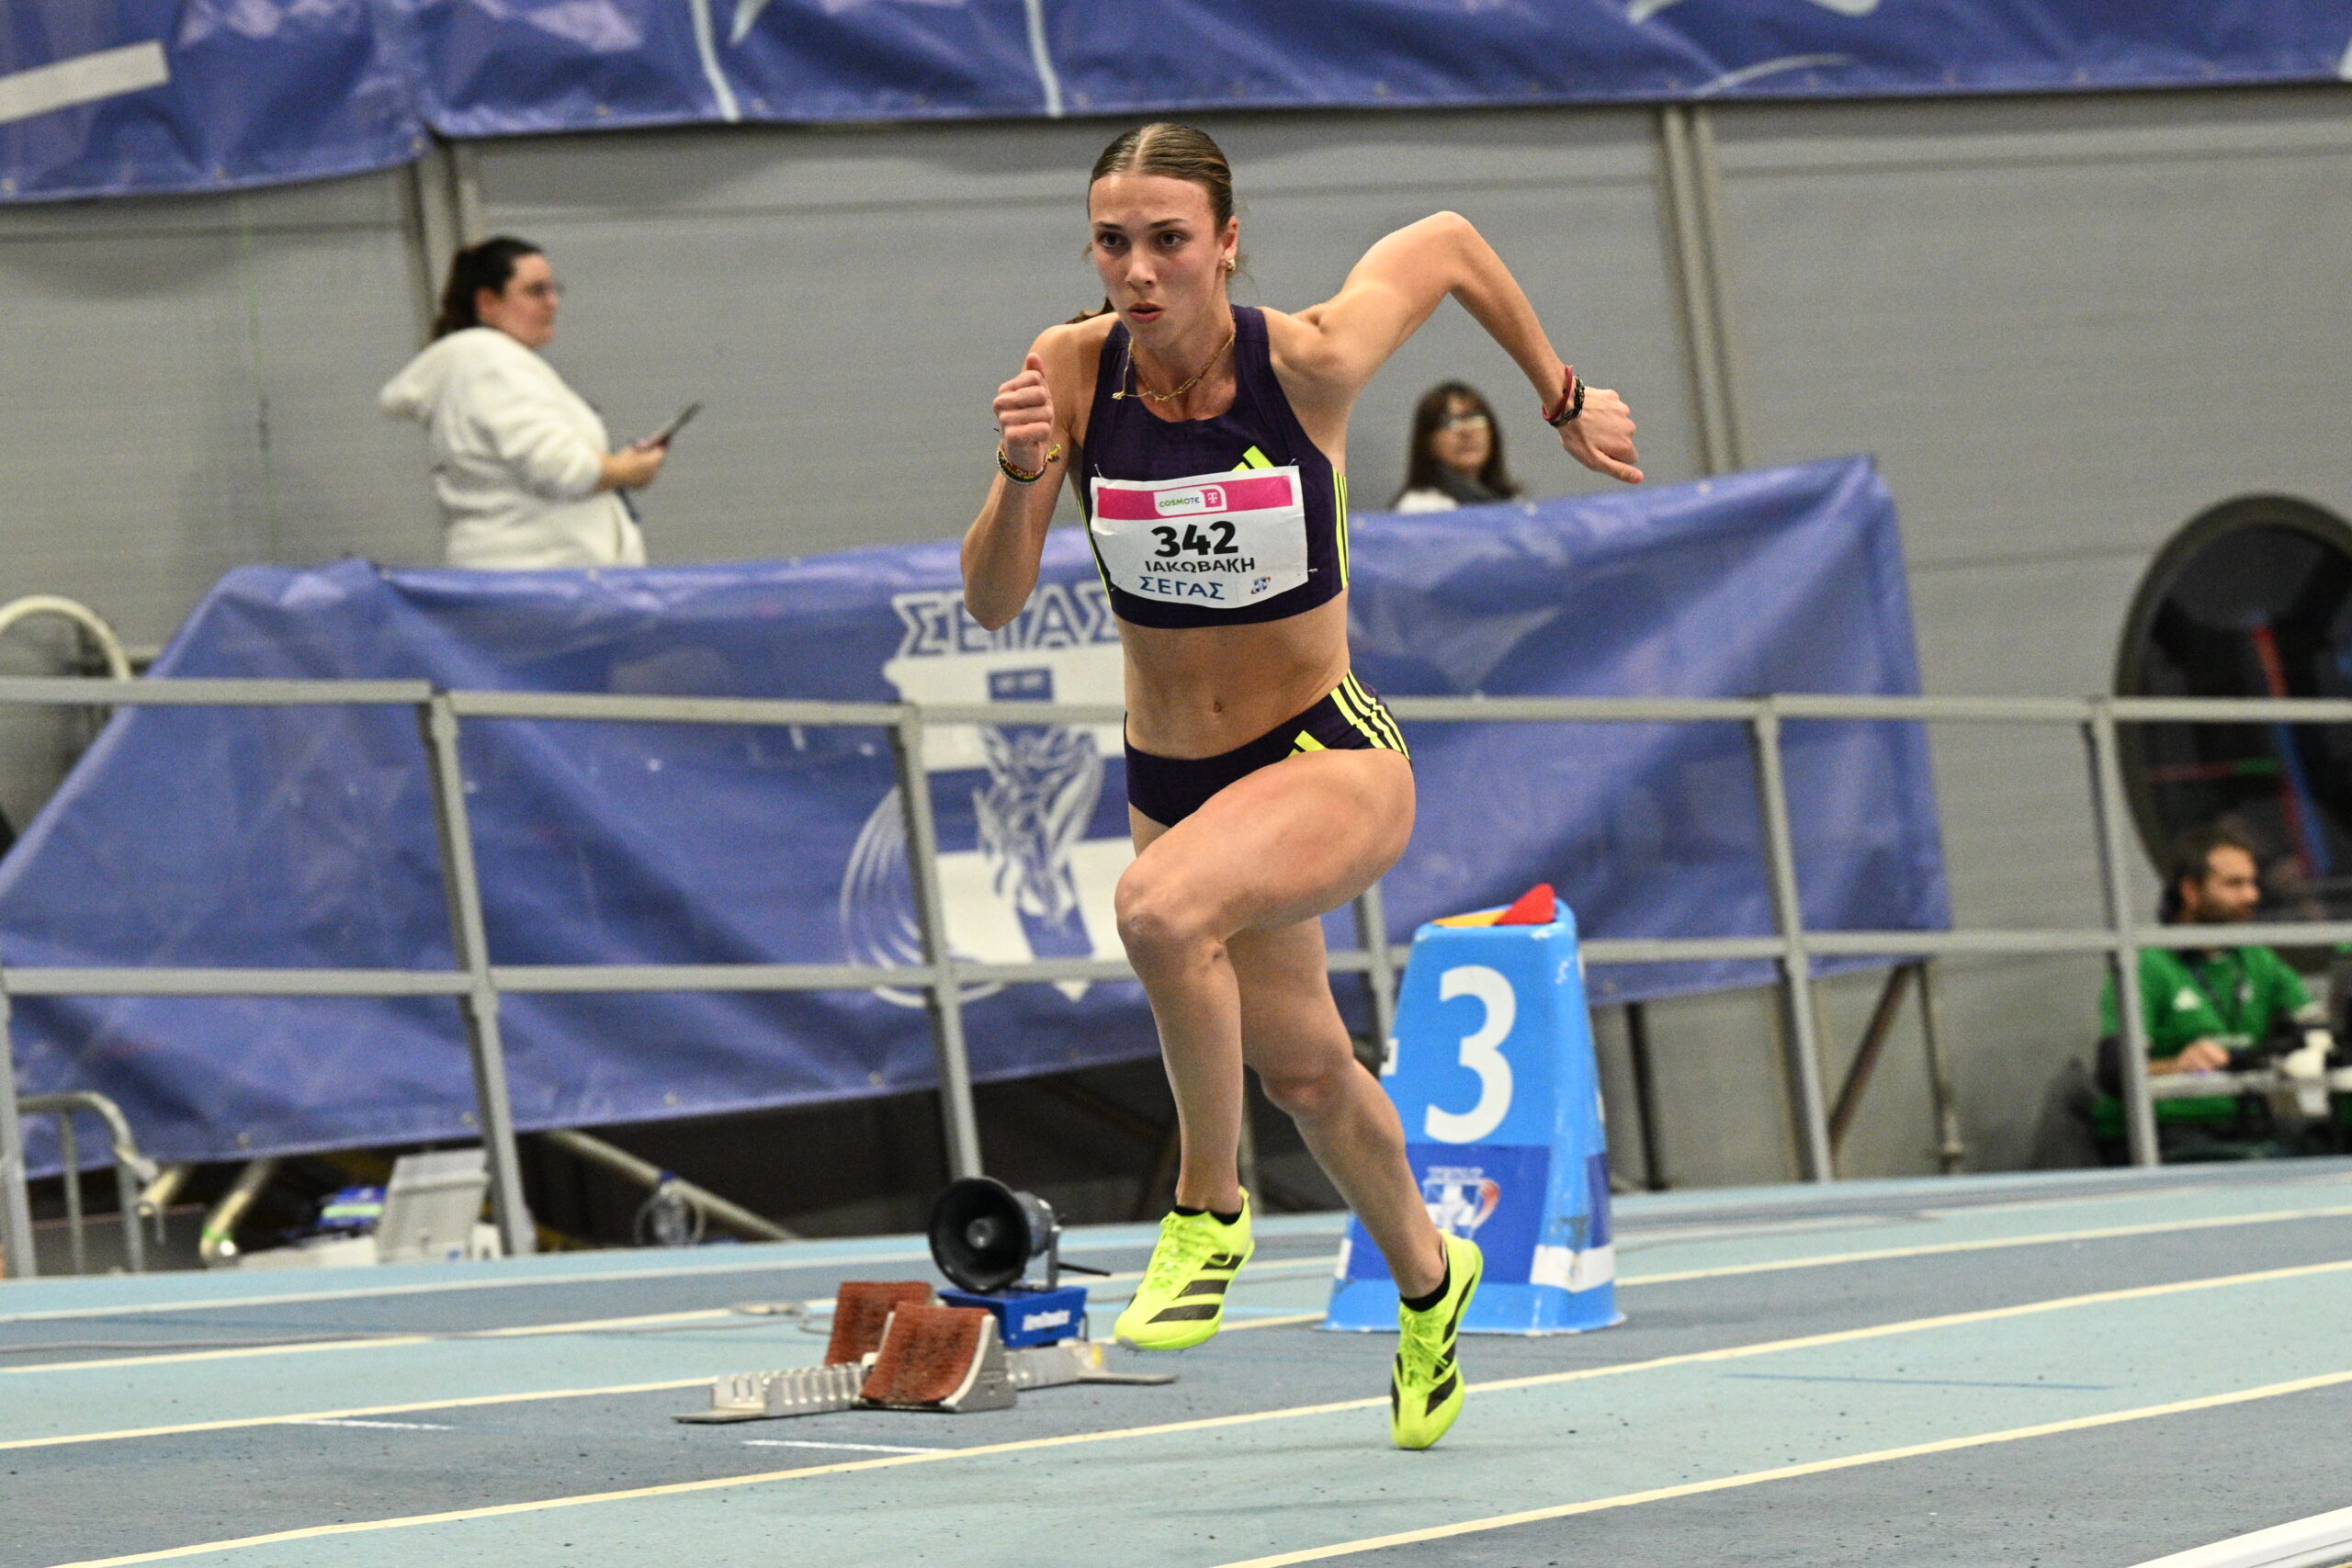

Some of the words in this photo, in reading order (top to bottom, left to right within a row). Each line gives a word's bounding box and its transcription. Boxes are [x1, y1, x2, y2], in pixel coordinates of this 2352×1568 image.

[1159, 497, 1200, 507] COSMOTE
[1151, 521, 1238, 558] 342
[1145, 558, 1255, 573] ΙΑΚΩΒΑΚΗ
[1139, 576, 1225, 600] ΣΕΓΑΣ
[1424, 965, 1516, 1144] 3
